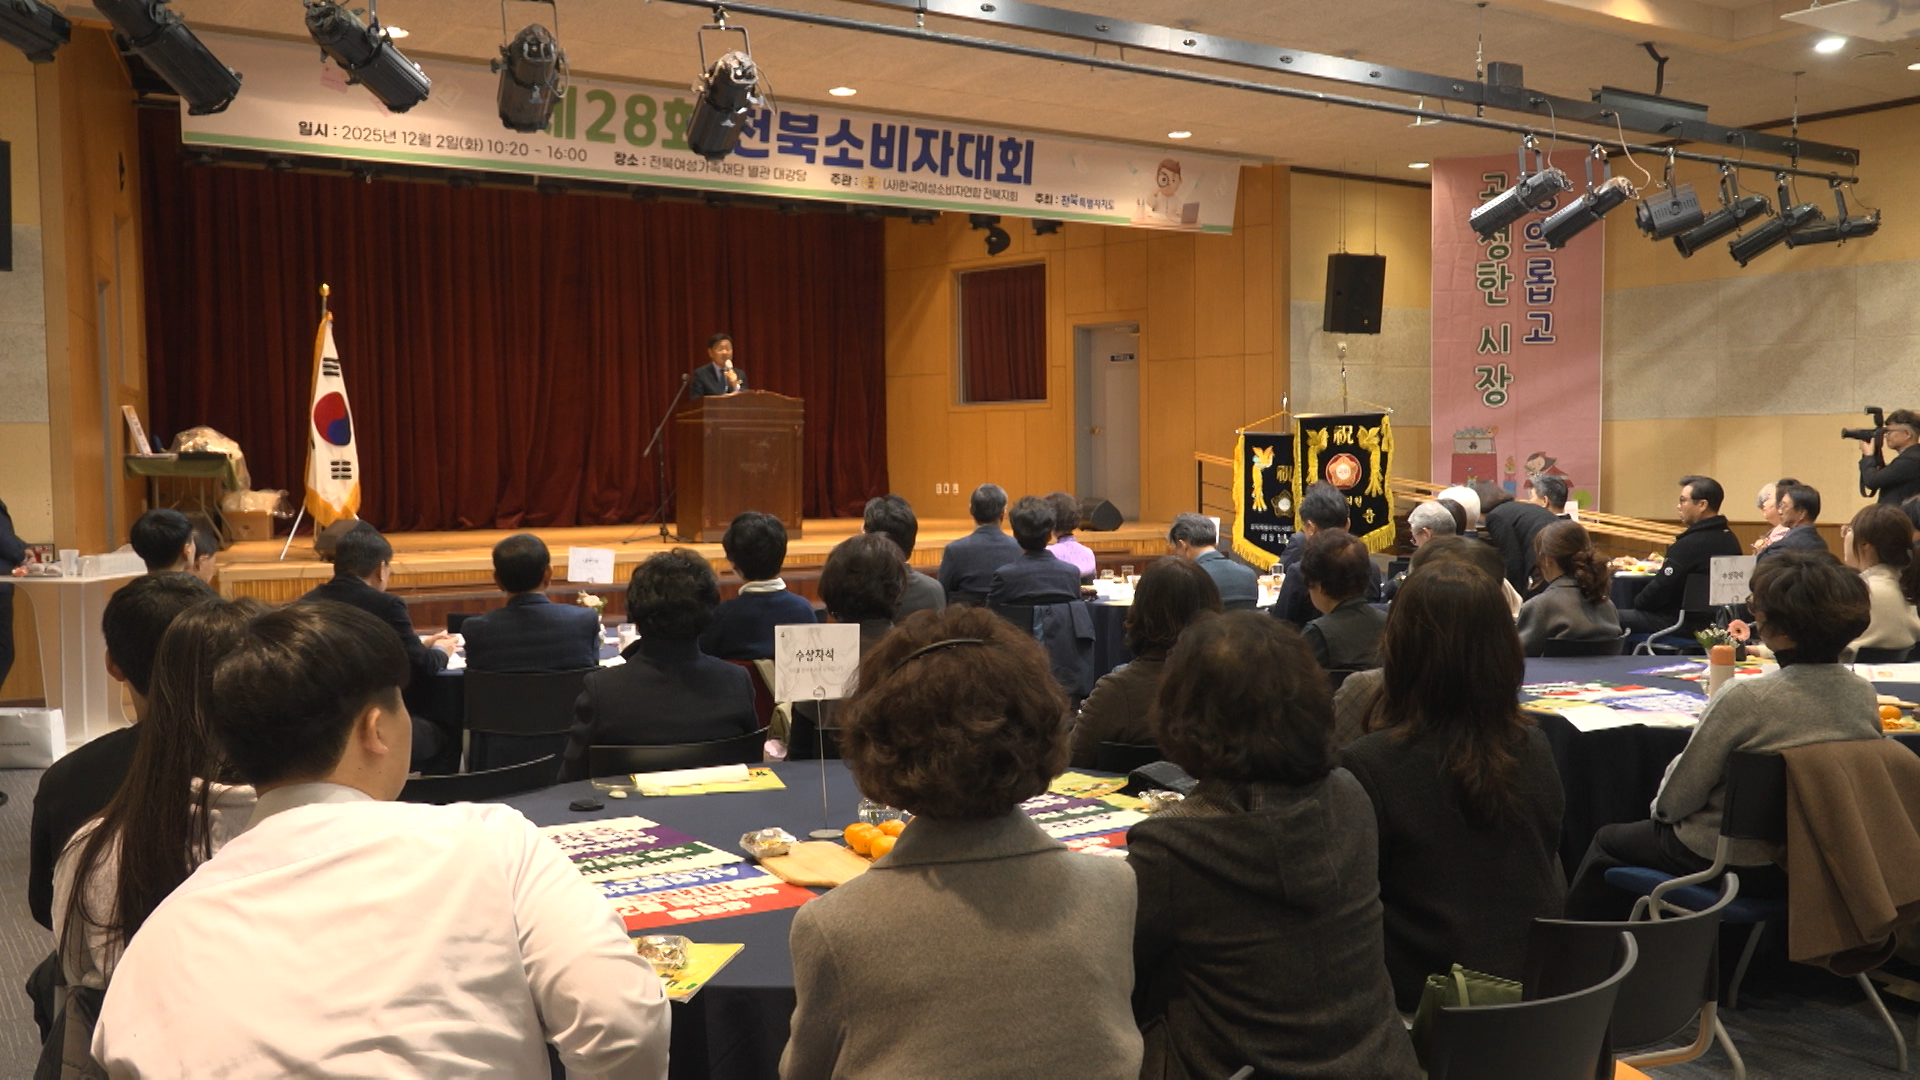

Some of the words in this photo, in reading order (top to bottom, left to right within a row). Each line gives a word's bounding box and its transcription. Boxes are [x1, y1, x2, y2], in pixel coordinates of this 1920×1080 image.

[298, 121, 329, 138] 일시
[341, 125, 397, 144] 2025년
[401, 131, 432, 148] 12월
[436, 135, 483, 152] 2일(화)
[487, 139, 530, 156] 10:20
[547, 145, 588, 162] 16:00
[732, 108, 1034, 185] 전북소비자대회
[614, 151, 639, 166] 장소
[748, 165, 771, 178] 별관
[773, 167, 807, 182] 대강당
[830, 173, 853, 187] 주관
[883, 177, 982, 200] (사)한국여성소비자연합
[983, 188, 1019, 202] 전북지회
[1035, 192, 1054, 204] 주최
[1475, 323, 1514, 408] 시장
[1333, 425, 1355, 445] 祝
[795, 647, 835, 663] 수상자석
